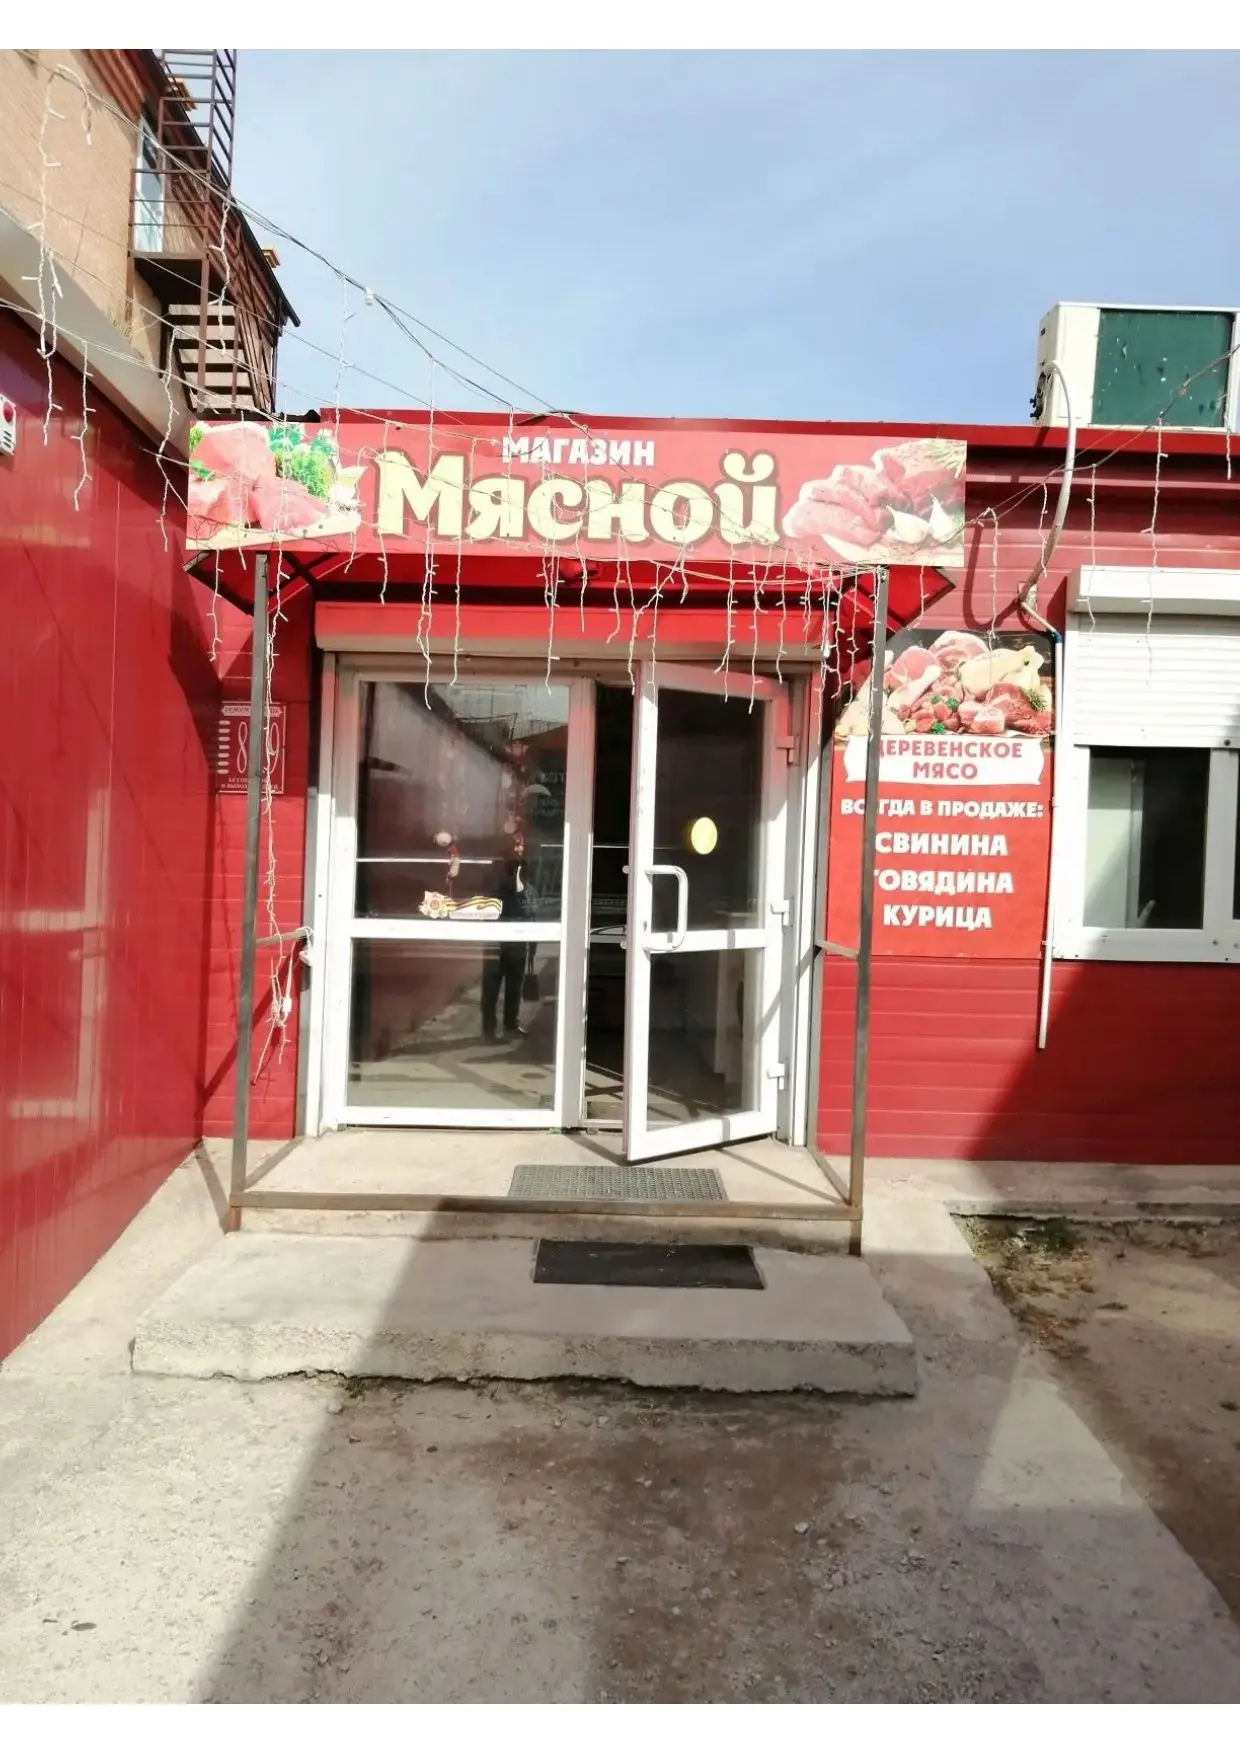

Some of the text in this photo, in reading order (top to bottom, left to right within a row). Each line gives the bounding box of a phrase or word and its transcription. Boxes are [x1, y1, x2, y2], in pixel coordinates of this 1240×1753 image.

[501, 435, 656, 468] МАГАЗИН
[376, 450, 780, 546] Мясной
[912, 762, 979, 780] МЯСО
[840, 798, 1044, 819] ВСГДА В ПРОДАЖЕ:
[875, 832, 1008, 857] СВИНИНА
[874, 869, 1014, 896] ОВЯДИНА
[883, 904, 993, 932] КУРИЦА
